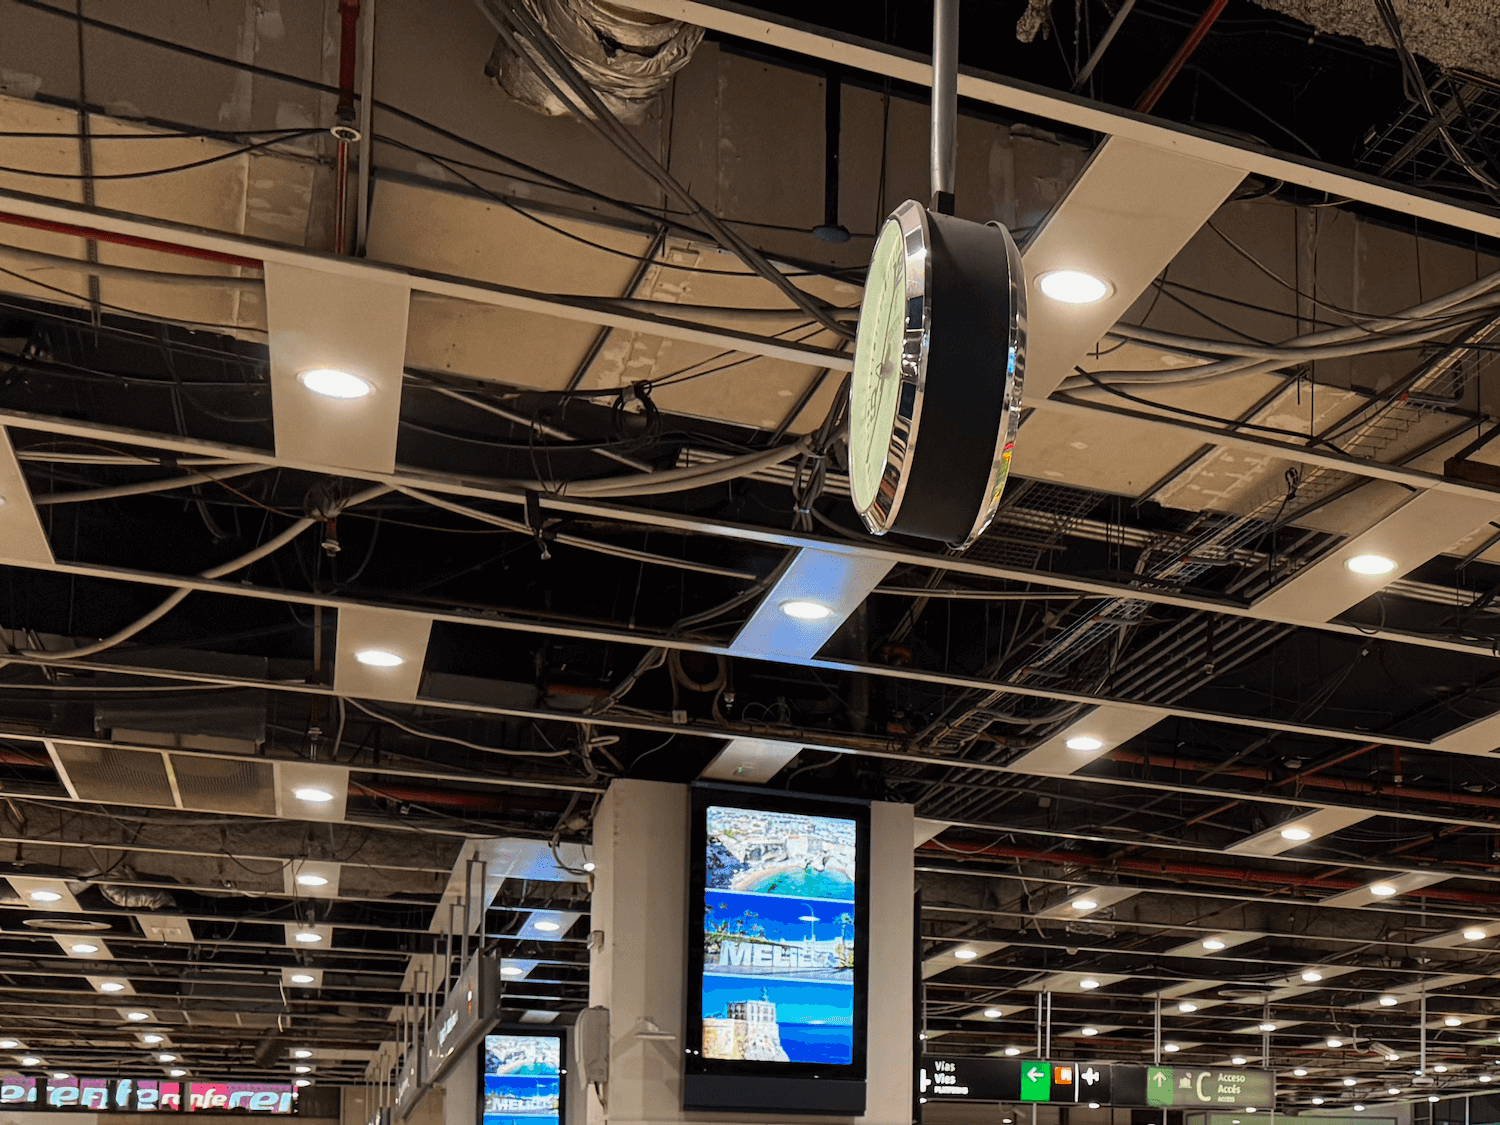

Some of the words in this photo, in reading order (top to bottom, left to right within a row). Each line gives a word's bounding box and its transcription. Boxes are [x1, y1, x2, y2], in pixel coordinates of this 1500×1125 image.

[934, 1060, 956, 1072] Vías
[1217, 1073, 1246, 1083] Acceso
[1196, 1071, 1211, 1102] C
[1217, 1084, 1241, 1094] Accés
